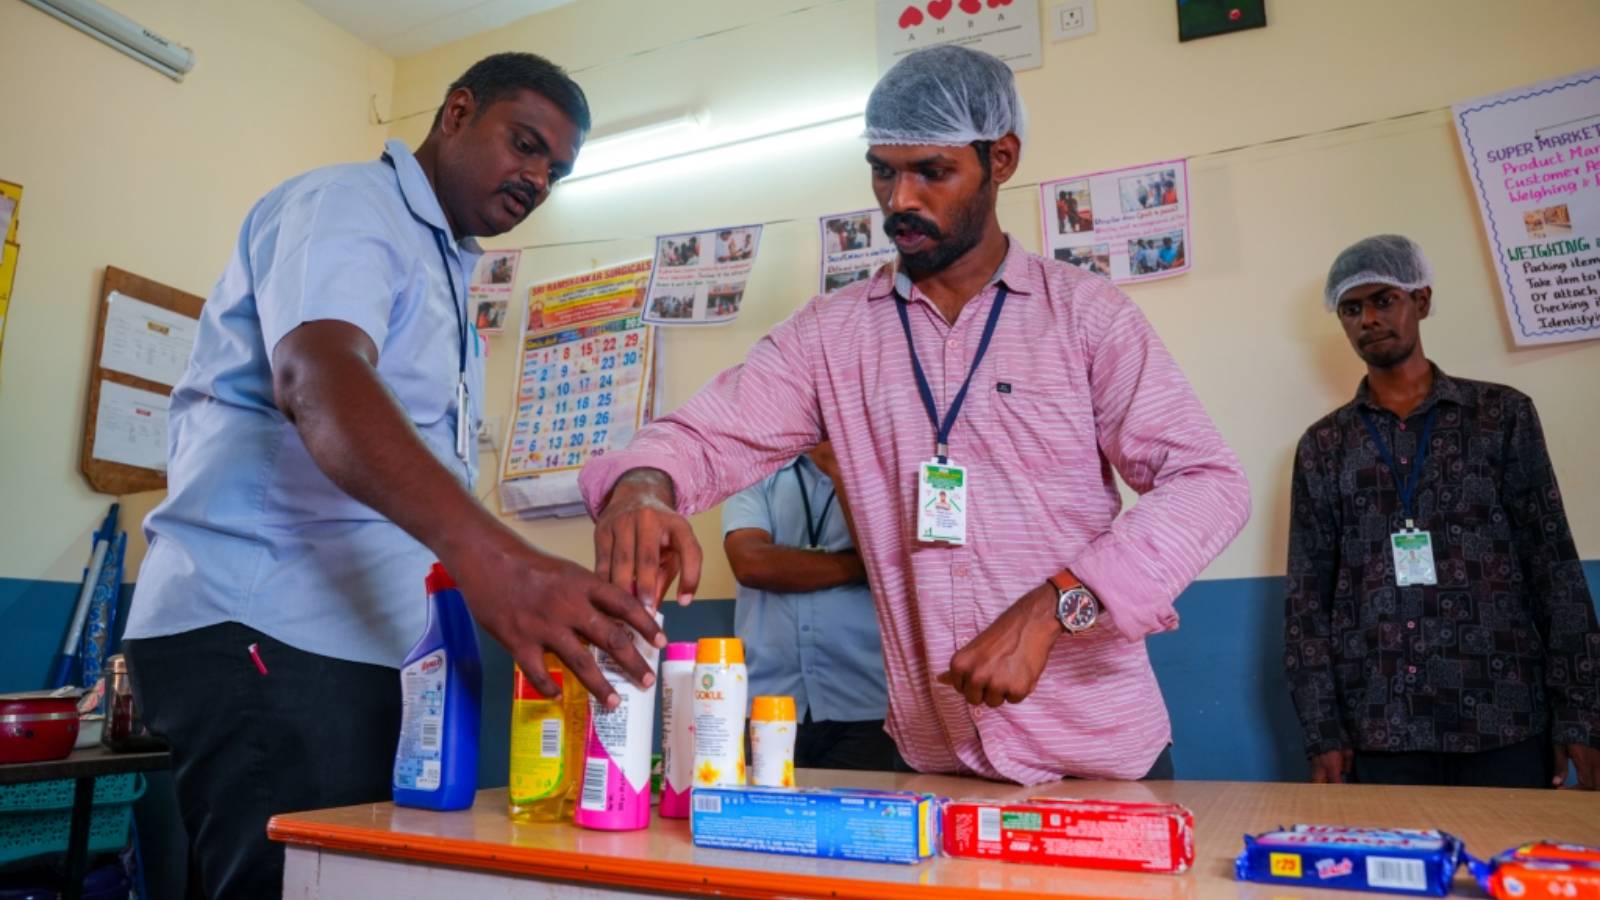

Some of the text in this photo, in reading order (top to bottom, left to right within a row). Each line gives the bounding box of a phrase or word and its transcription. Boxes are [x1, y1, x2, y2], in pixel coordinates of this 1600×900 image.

[1487, 142, 1533, 163] SUPER
[1503, 152, 1564, 174] Product
[1504, 167, 1580, 190] Customer
[1508, 181, 1577, 203] Weighing
[1507, 237, 1590, 262] WEIGHING
[1523, 260, 1567, 274] Packing
[1526, 271, 1596, 289] Take item to
[1553, 284, 1598, 299] attach
[1534, 300, 1590, 314] Checking
[544, 352, 549, 363] 1
[581, 342, 592, 357] 15
[603, 337, 617, 352] 22
[624, 333, 638, 348] 29
[541, 368, 548, 382] 2
[561, 364, 568, 378] 9
[601, 356, 615, 370] 23
[623, 351, 636, 365] 30
[539, 386, 546, 400] 3
[557, 382, 570, 396] 10
[579, 377, 590, 389] 17
[600, 374, 612, 389] 24
[536, 404, 543, 417] 4
[556, 401, 567, 415] 11
[598, 392, 611, 407] 25
[533, 421, 539, 435] 5
[552, 418, 565, 432] 12
[574, 414, 586, 428] 19
[594, 411, 609, 426] 26
[529, 439, 536, 452] 6
[549, 436, 562, 450] 13
[570, 432, 584, 447] 20
[592, 429, 607, 444] 27
[546, 454, 559, 468] 14
[568, 452, 581, 466] 21
